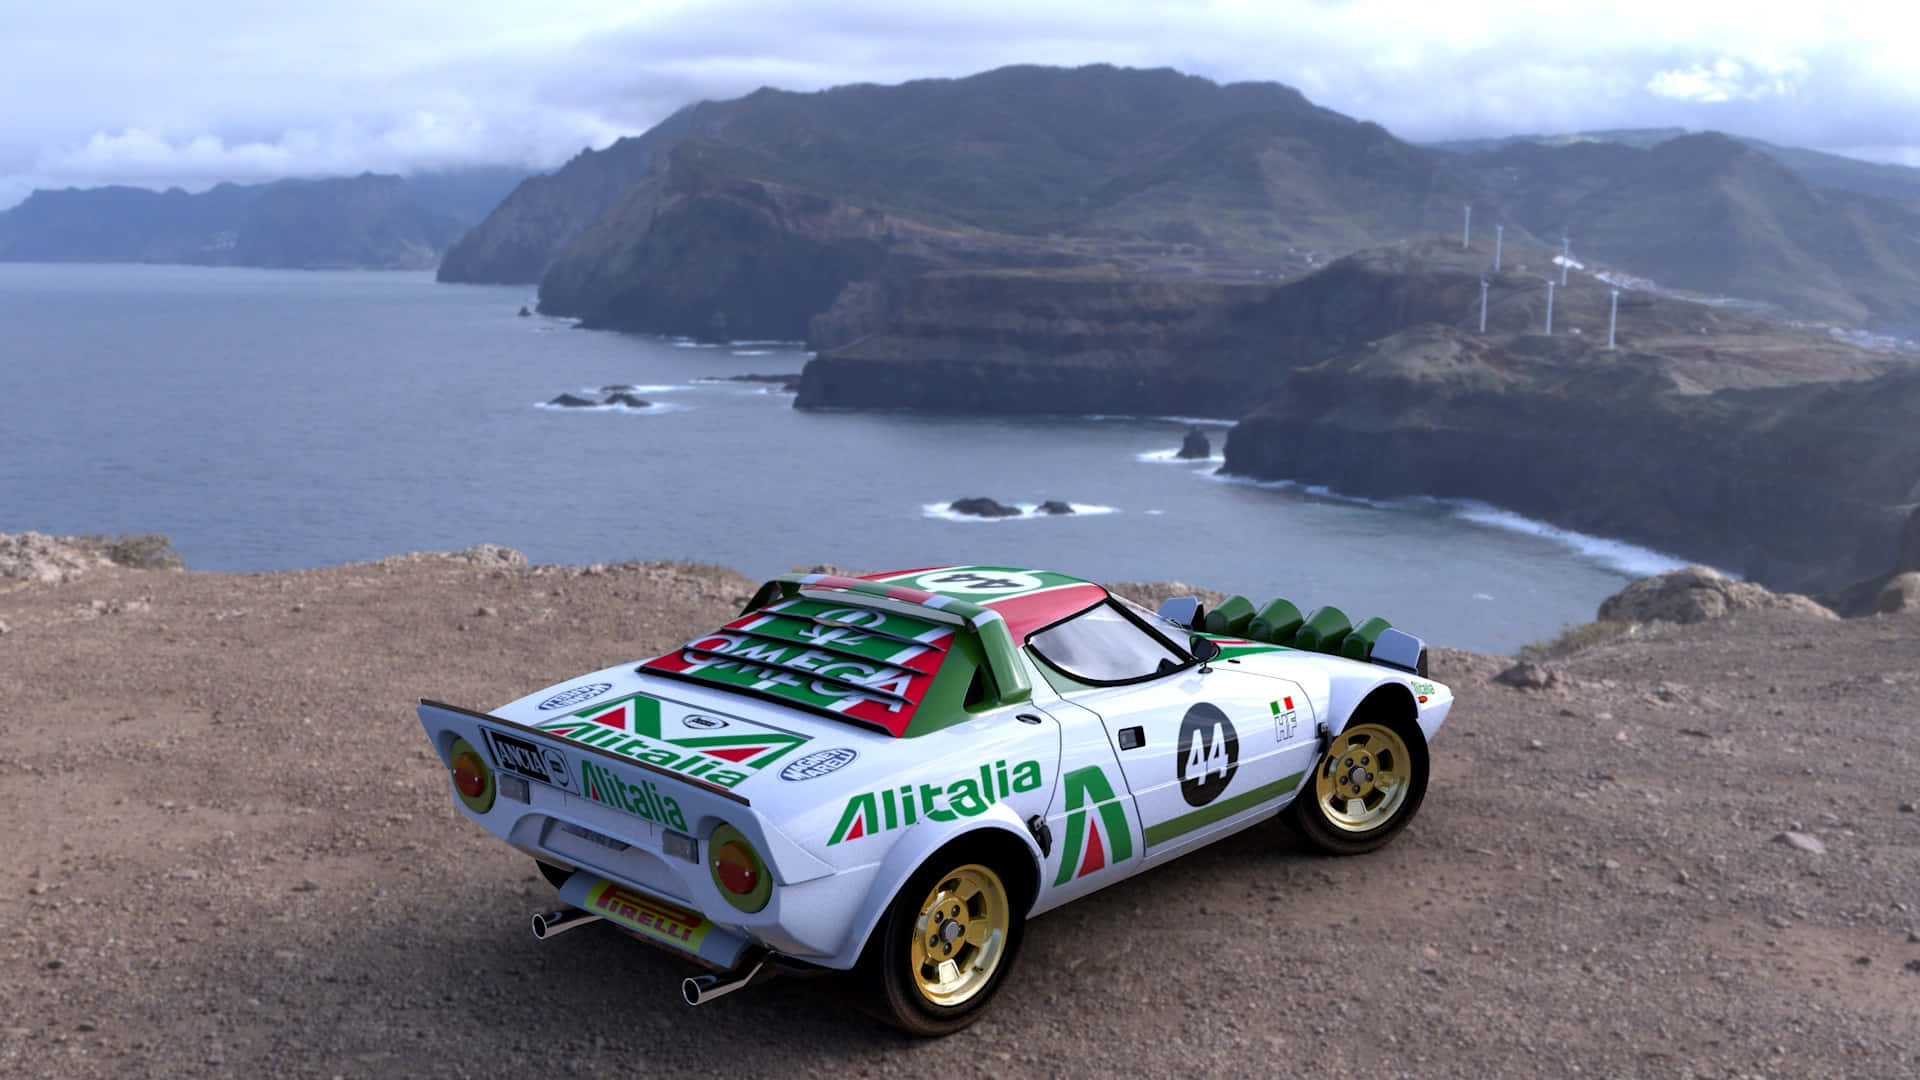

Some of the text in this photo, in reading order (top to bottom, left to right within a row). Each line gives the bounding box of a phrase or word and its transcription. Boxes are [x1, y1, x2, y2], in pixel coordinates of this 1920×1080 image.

[537, 722, 749, 788] Alitalia
[1185, 722, 1228, 786] 44
[1274, 711, 1297, 743] HF
[581, 759, 688, 832] Alitalia
[826, 759, 1042, 847] Alitalia
[595, 885, 703, 941] PIRELLI
